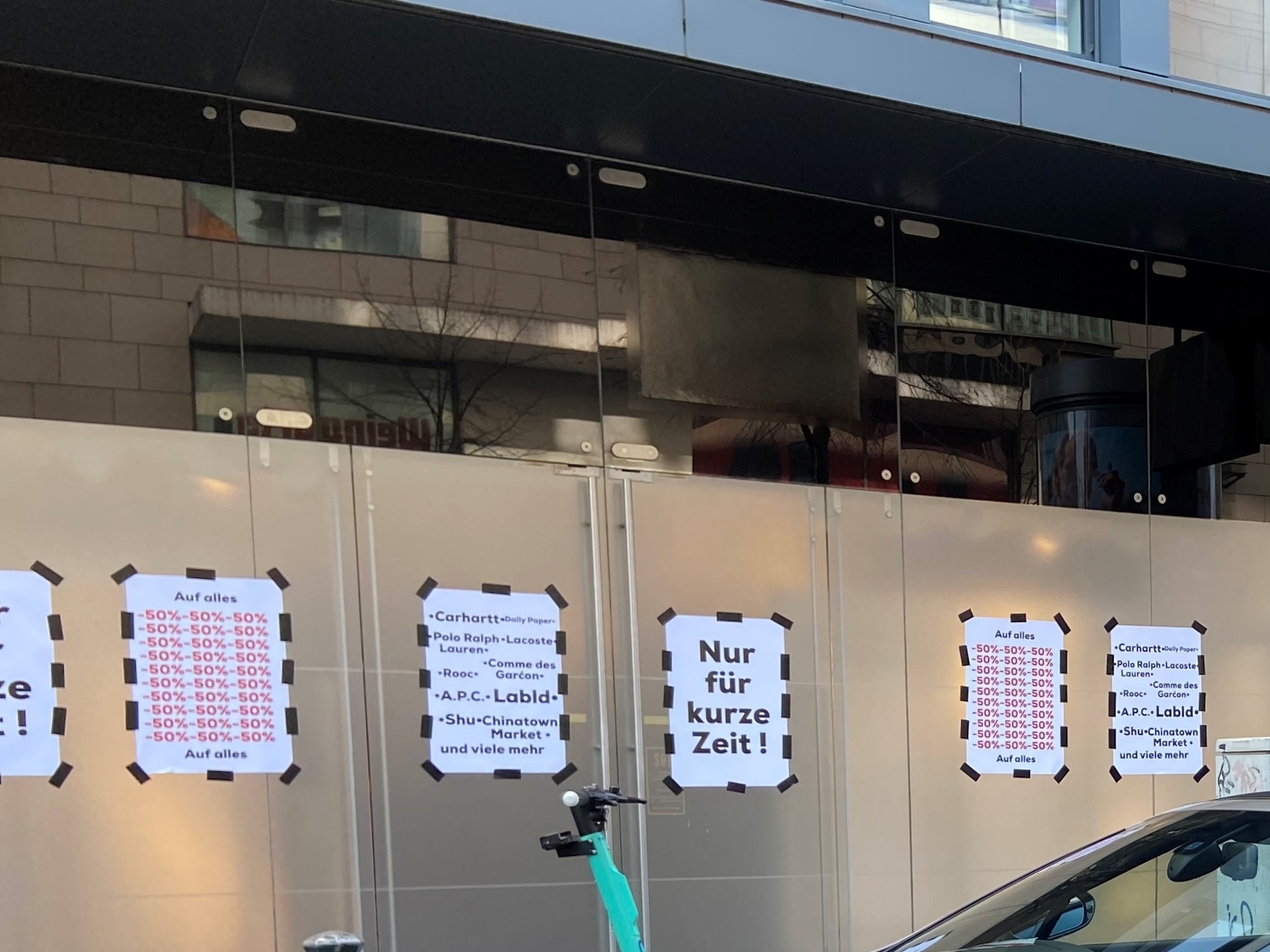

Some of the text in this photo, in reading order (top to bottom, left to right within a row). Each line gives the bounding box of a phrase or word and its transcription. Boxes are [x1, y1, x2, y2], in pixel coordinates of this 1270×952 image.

[174, 592, 237, 603] Auf alles
[464, 633, 500, 645] Ralph
[995, 630, 1035, 640] Auf alles
[699, 640, 756, 663] Nur
[535, 660, 556, 669] des
[1137, 661, 1160, 670] Ralph
[705, 671, 751, 694] für
[687, 701, 770, 724] kurze
[491, 729, 542, 739] Market
[1153, 738, 1187, 747] Market
[185, 749, 247, 759] Auf alles
[441, 744, 544, 754] und viele mehr
[996, 754, 1036, 763] Auf alles
[1120, 751, 1188, 759] und viele mehr
